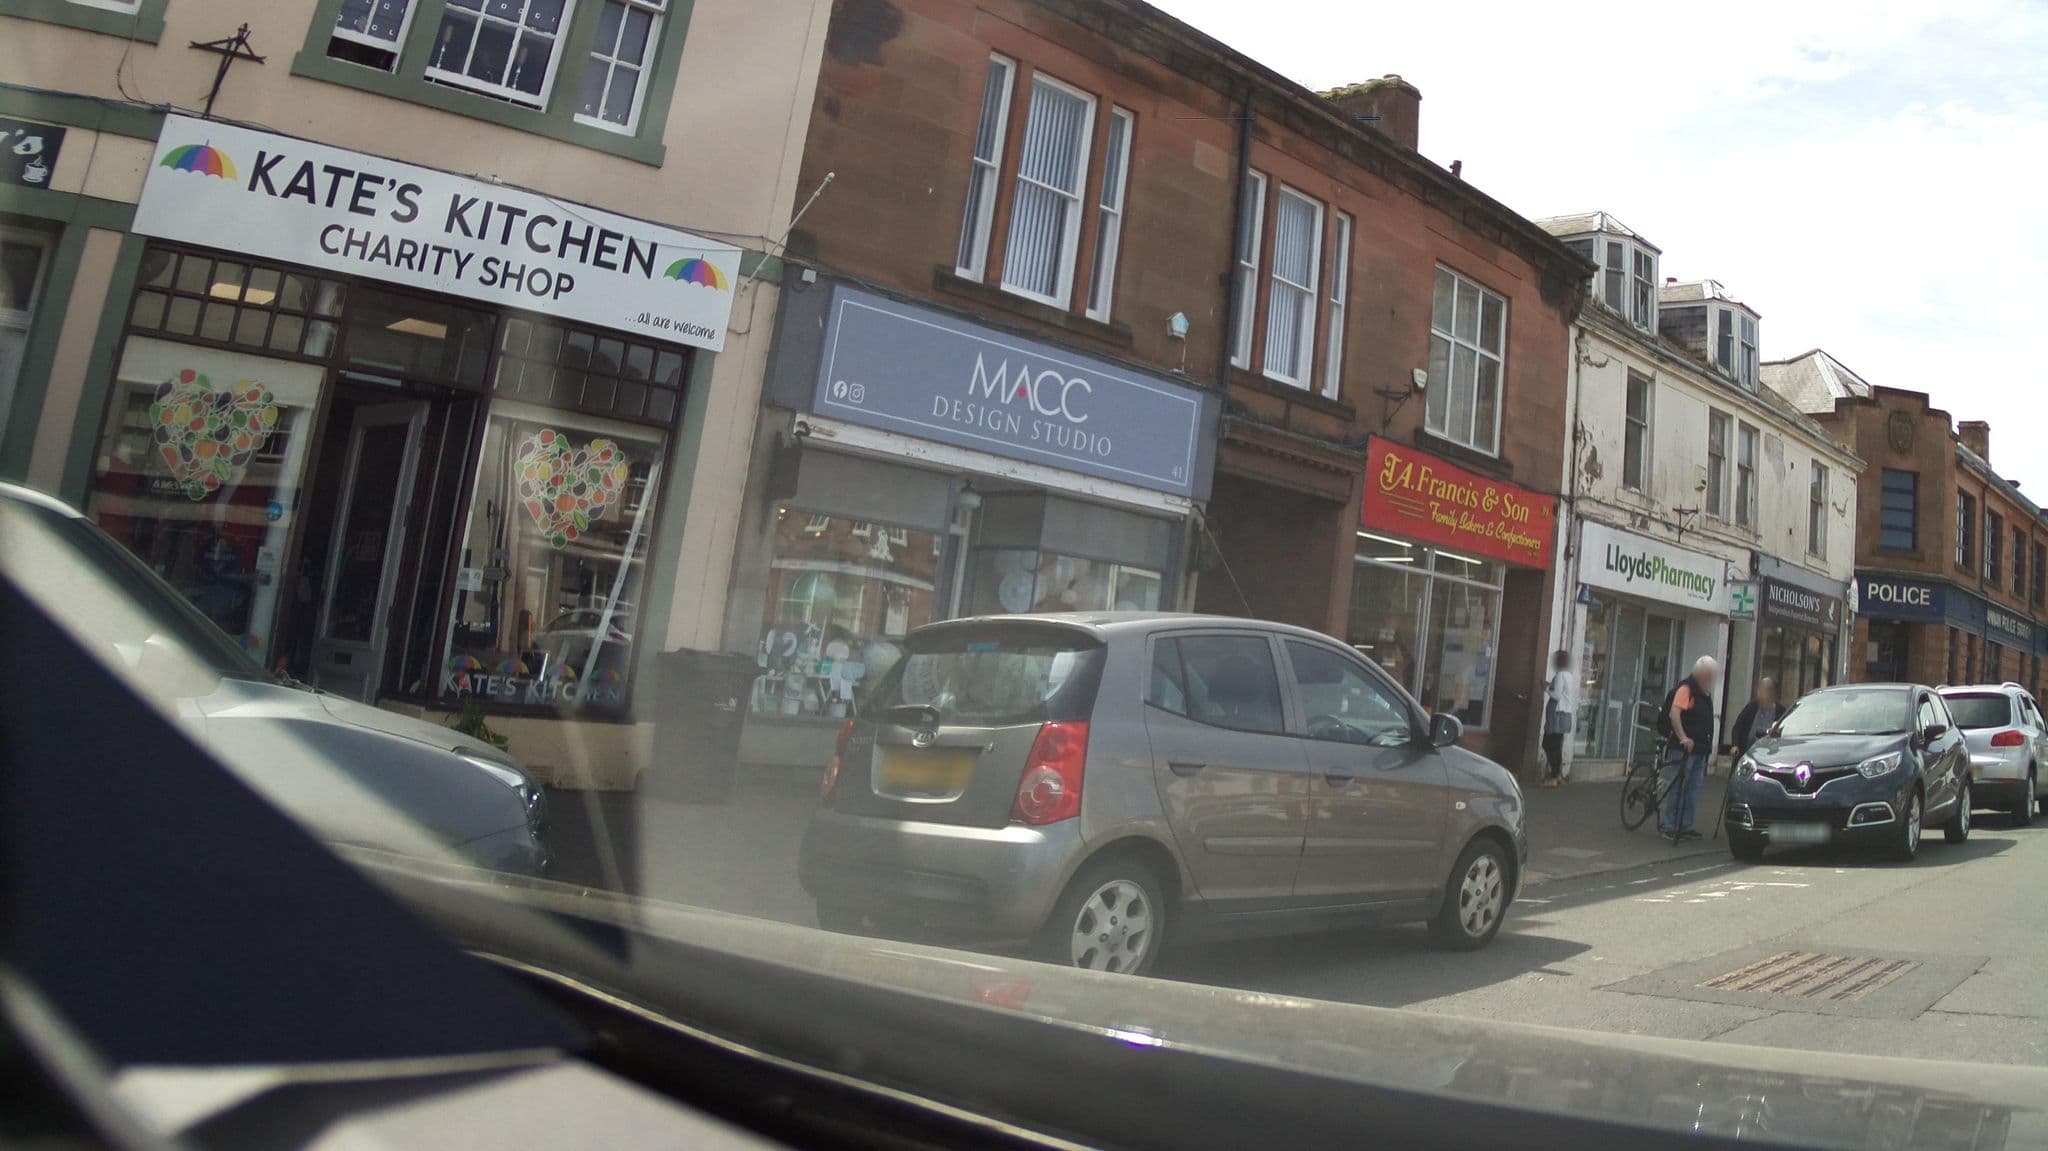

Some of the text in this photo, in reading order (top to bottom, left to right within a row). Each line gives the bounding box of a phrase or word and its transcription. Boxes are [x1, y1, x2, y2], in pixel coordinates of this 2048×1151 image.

[247, 150, 658, 280] KATE'S KITCHEN
[319, 224, 575, 300] CHARITY SHOP
[652, 316, 671, 329] are
[674, 320, 716, 340] welcome
[967, 351, 1093, 424] MACC
[932, 395, 1112, 457] DESIGN STUDIO
[1429, 501, 1457, 535] Family
[1485, 522, 1494, 537] &
[1482, 486, 1499, 512] &
[1501, 492, 1529, 523] Son
[1605, 543, 1716, 601] LloydsPharmacy
[1868, 583, 1931, 606] POLICE
[1769, 584, 1820, 612] NICHOLSON'S
